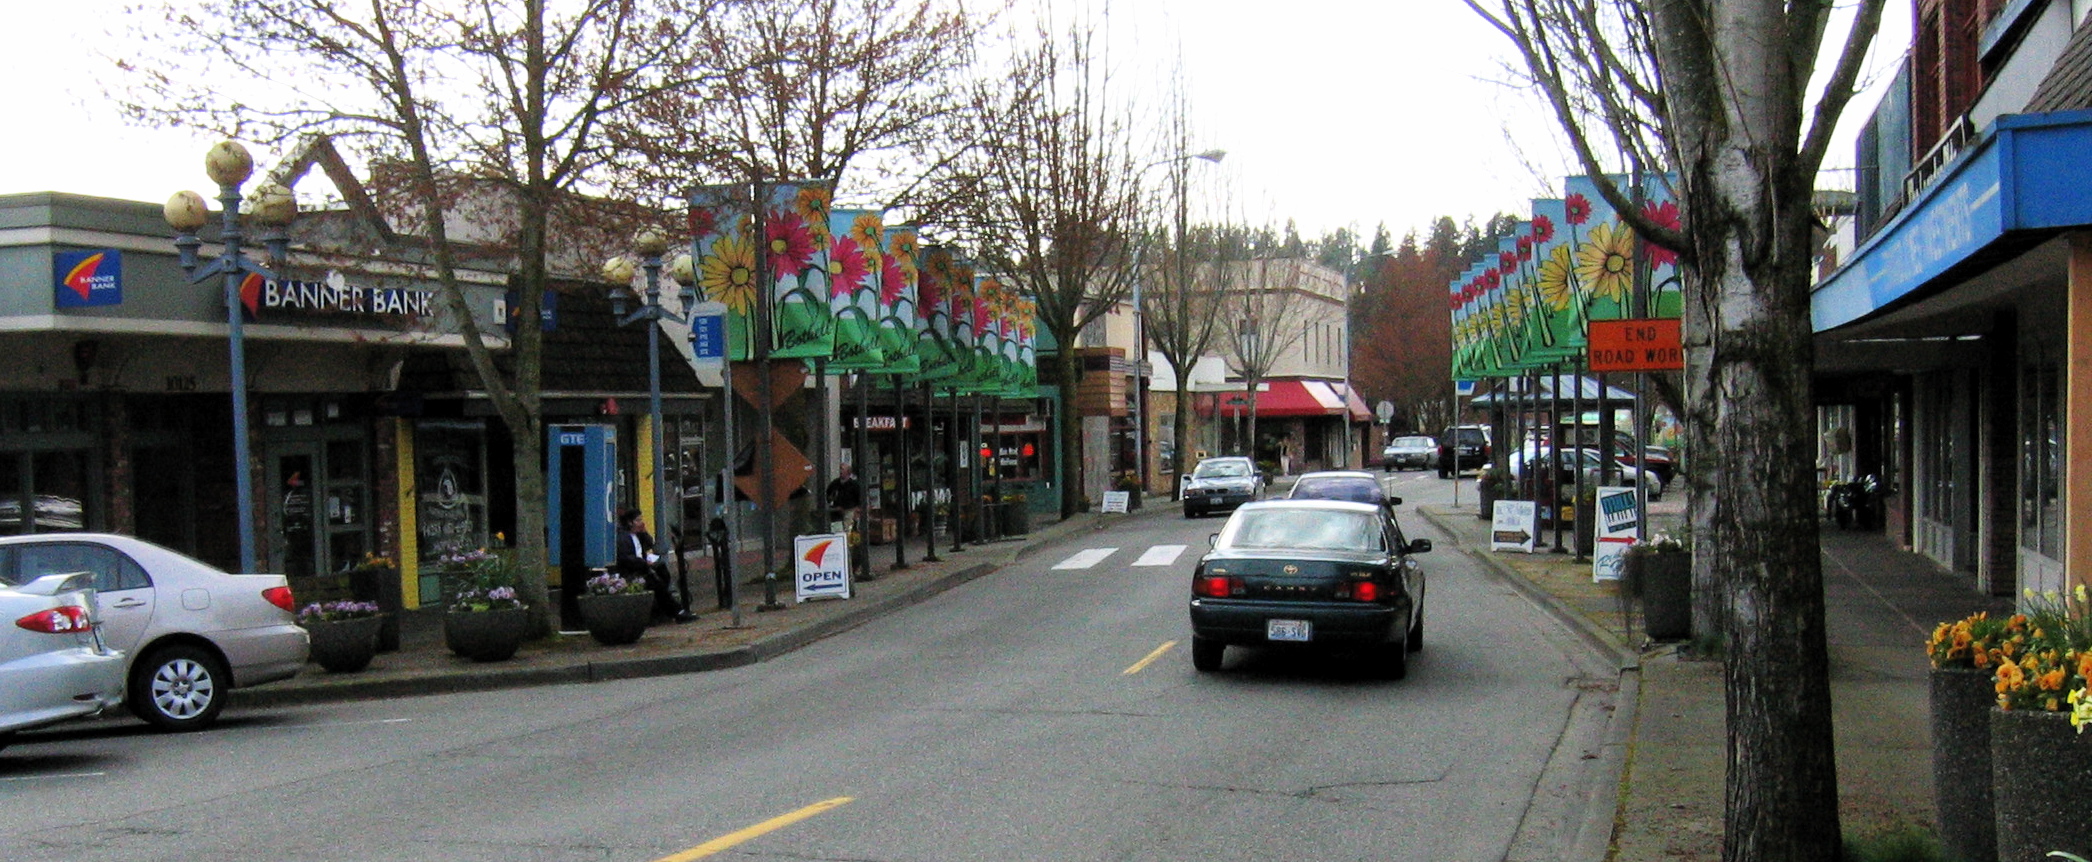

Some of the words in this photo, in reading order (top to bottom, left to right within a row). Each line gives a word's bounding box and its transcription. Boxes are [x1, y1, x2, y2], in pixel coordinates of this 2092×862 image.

[80, 275, 115, 284] BANNER
[91, 282, 116, 290] BANK
[265, 282, 364, 314] BANNER
[373, 288, 435, 317] BANK
[1625, 326, 1656, 342] END
[1594, 350, 1635, 364] ROAD
[1645, 348, 1683, 363] WOR
[853, 416, 908, 429] BEAKFAT
[560, 433, 585, 445] GTE
[803, 571, 842, 582] OPEN
